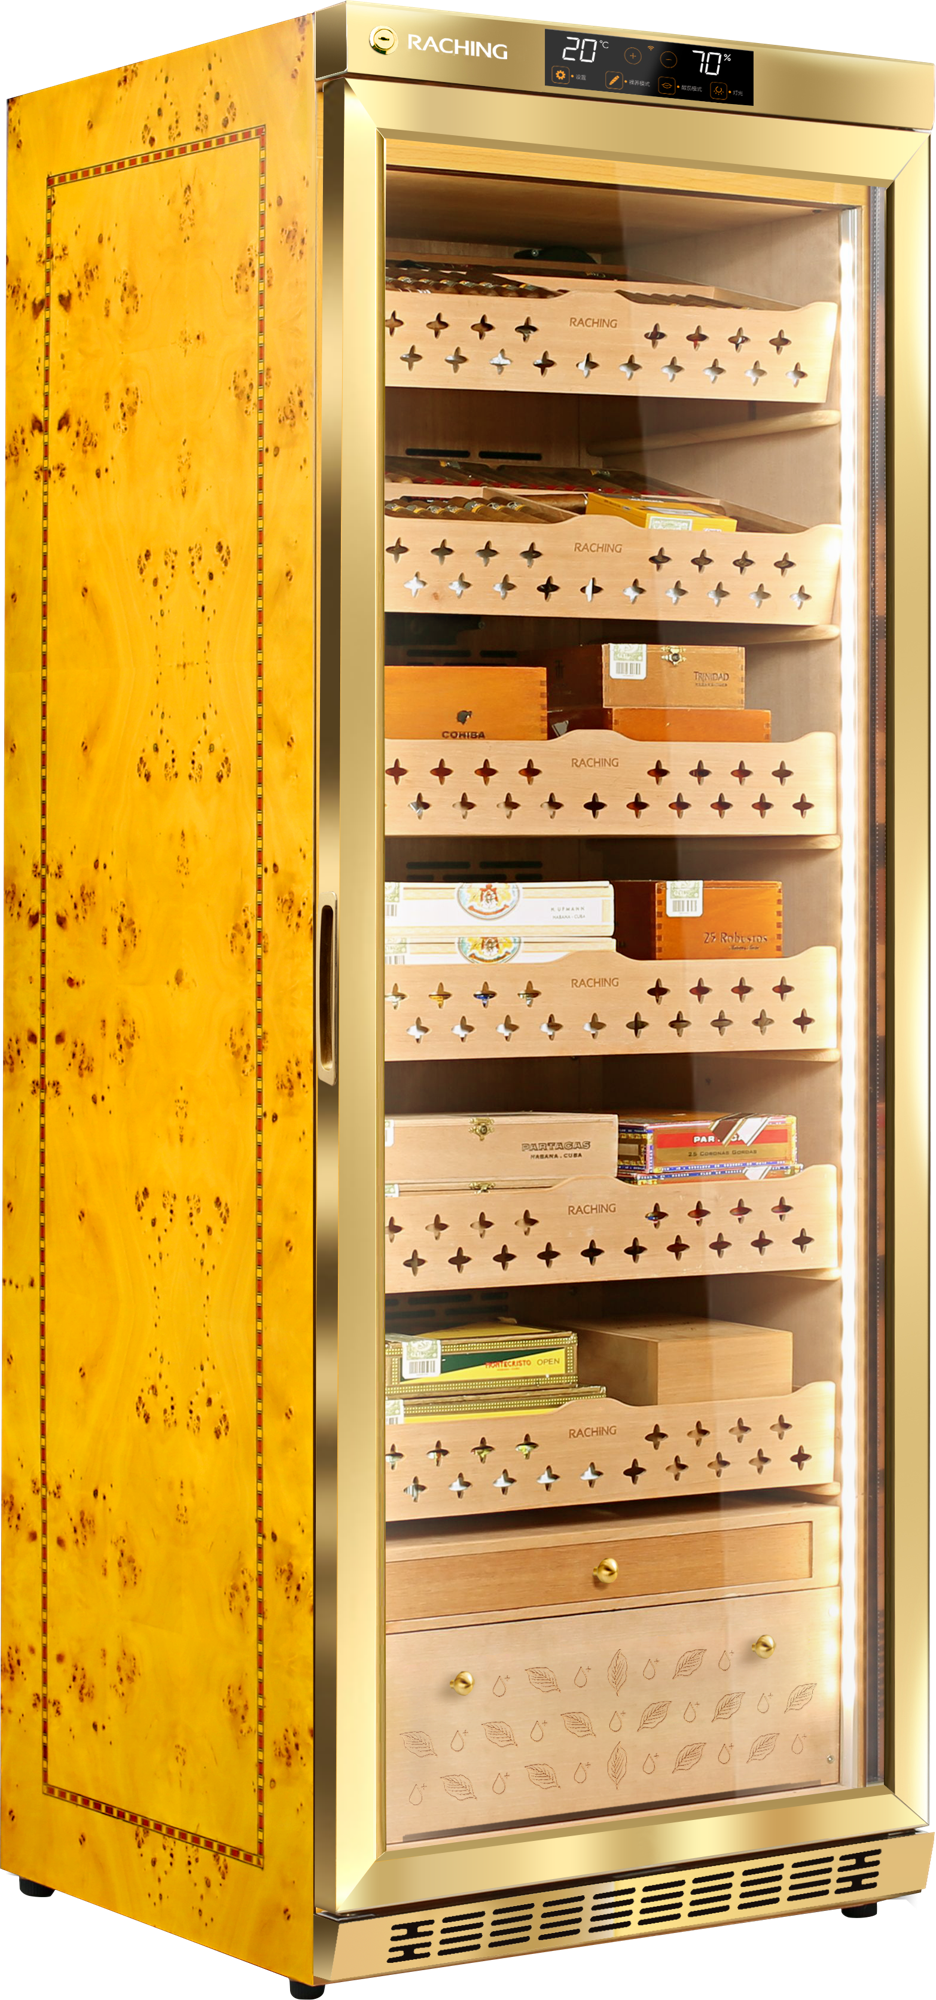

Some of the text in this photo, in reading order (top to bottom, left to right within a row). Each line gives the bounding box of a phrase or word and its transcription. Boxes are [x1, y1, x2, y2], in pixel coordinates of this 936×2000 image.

[408, 34, 508, 60] RACHING
[569, 317, 618, 329] RACHING
[573, 542, 623, 554] RACHING
[693, 671, 730, 682] TRINIDAD
[441, 731, 486, 739] COHIBA
[571, 757, 620, 768] RACHING
[704, 931, 716, 944] 25
[571, 977, 619, 989] RACHING
[568, 1204, 617, 1216] RACHING
[536, 1358, 560, 1366] OPEN
[568, 1426, 617, 1439] RACHING
